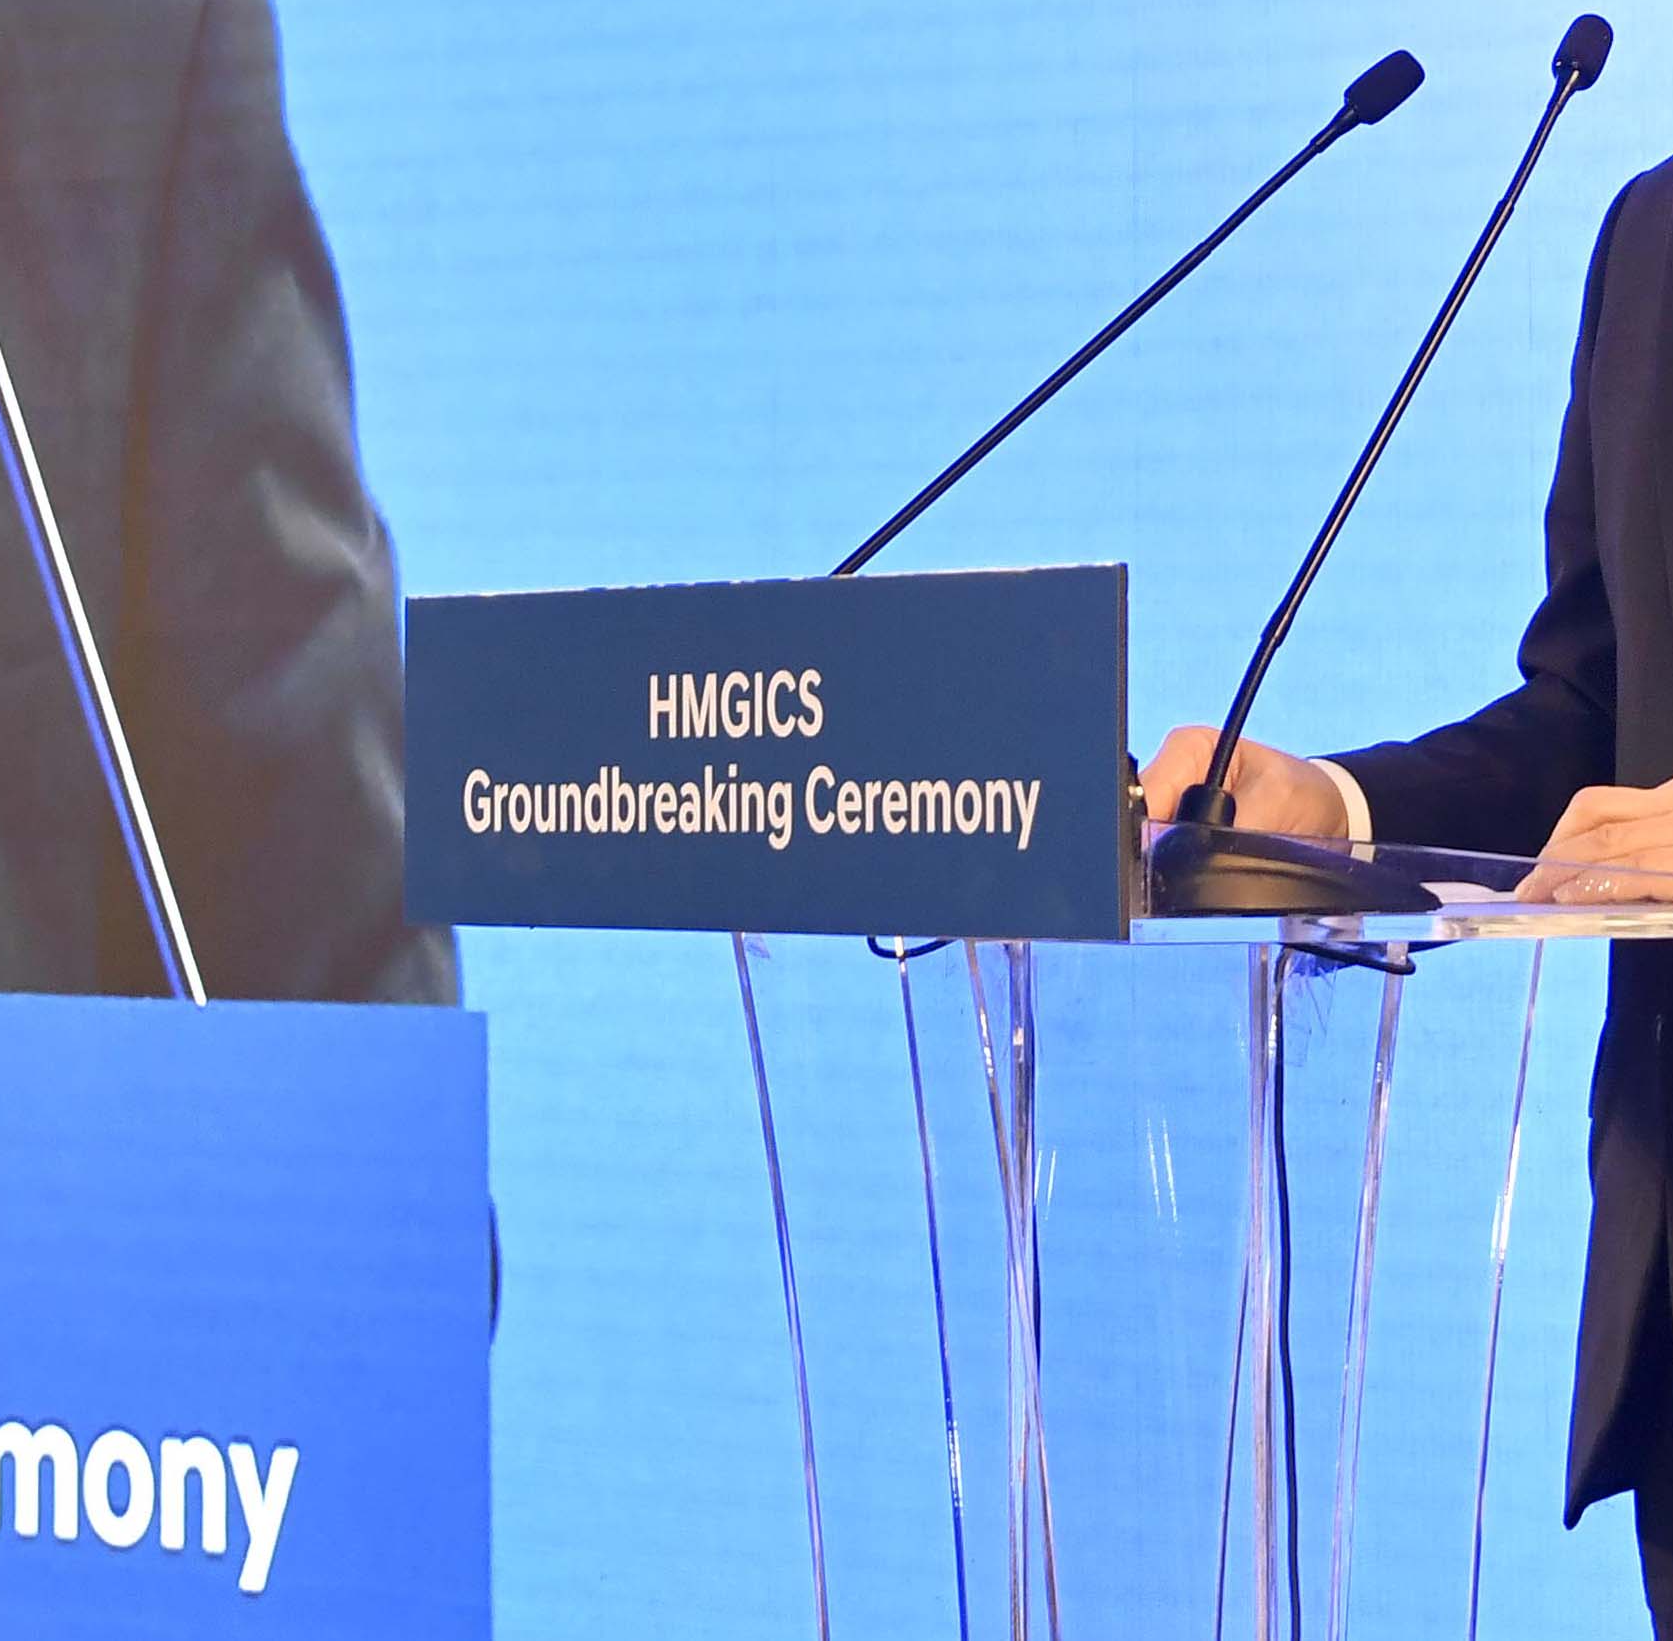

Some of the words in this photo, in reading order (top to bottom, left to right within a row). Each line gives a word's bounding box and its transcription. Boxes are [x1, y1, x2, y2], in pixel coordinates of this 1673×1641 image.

[648, 668, 825, 740] HMGICS
[462, 764, 794, 851] Groundbreaking
[803, 764, 1042, 851] Ceremony
